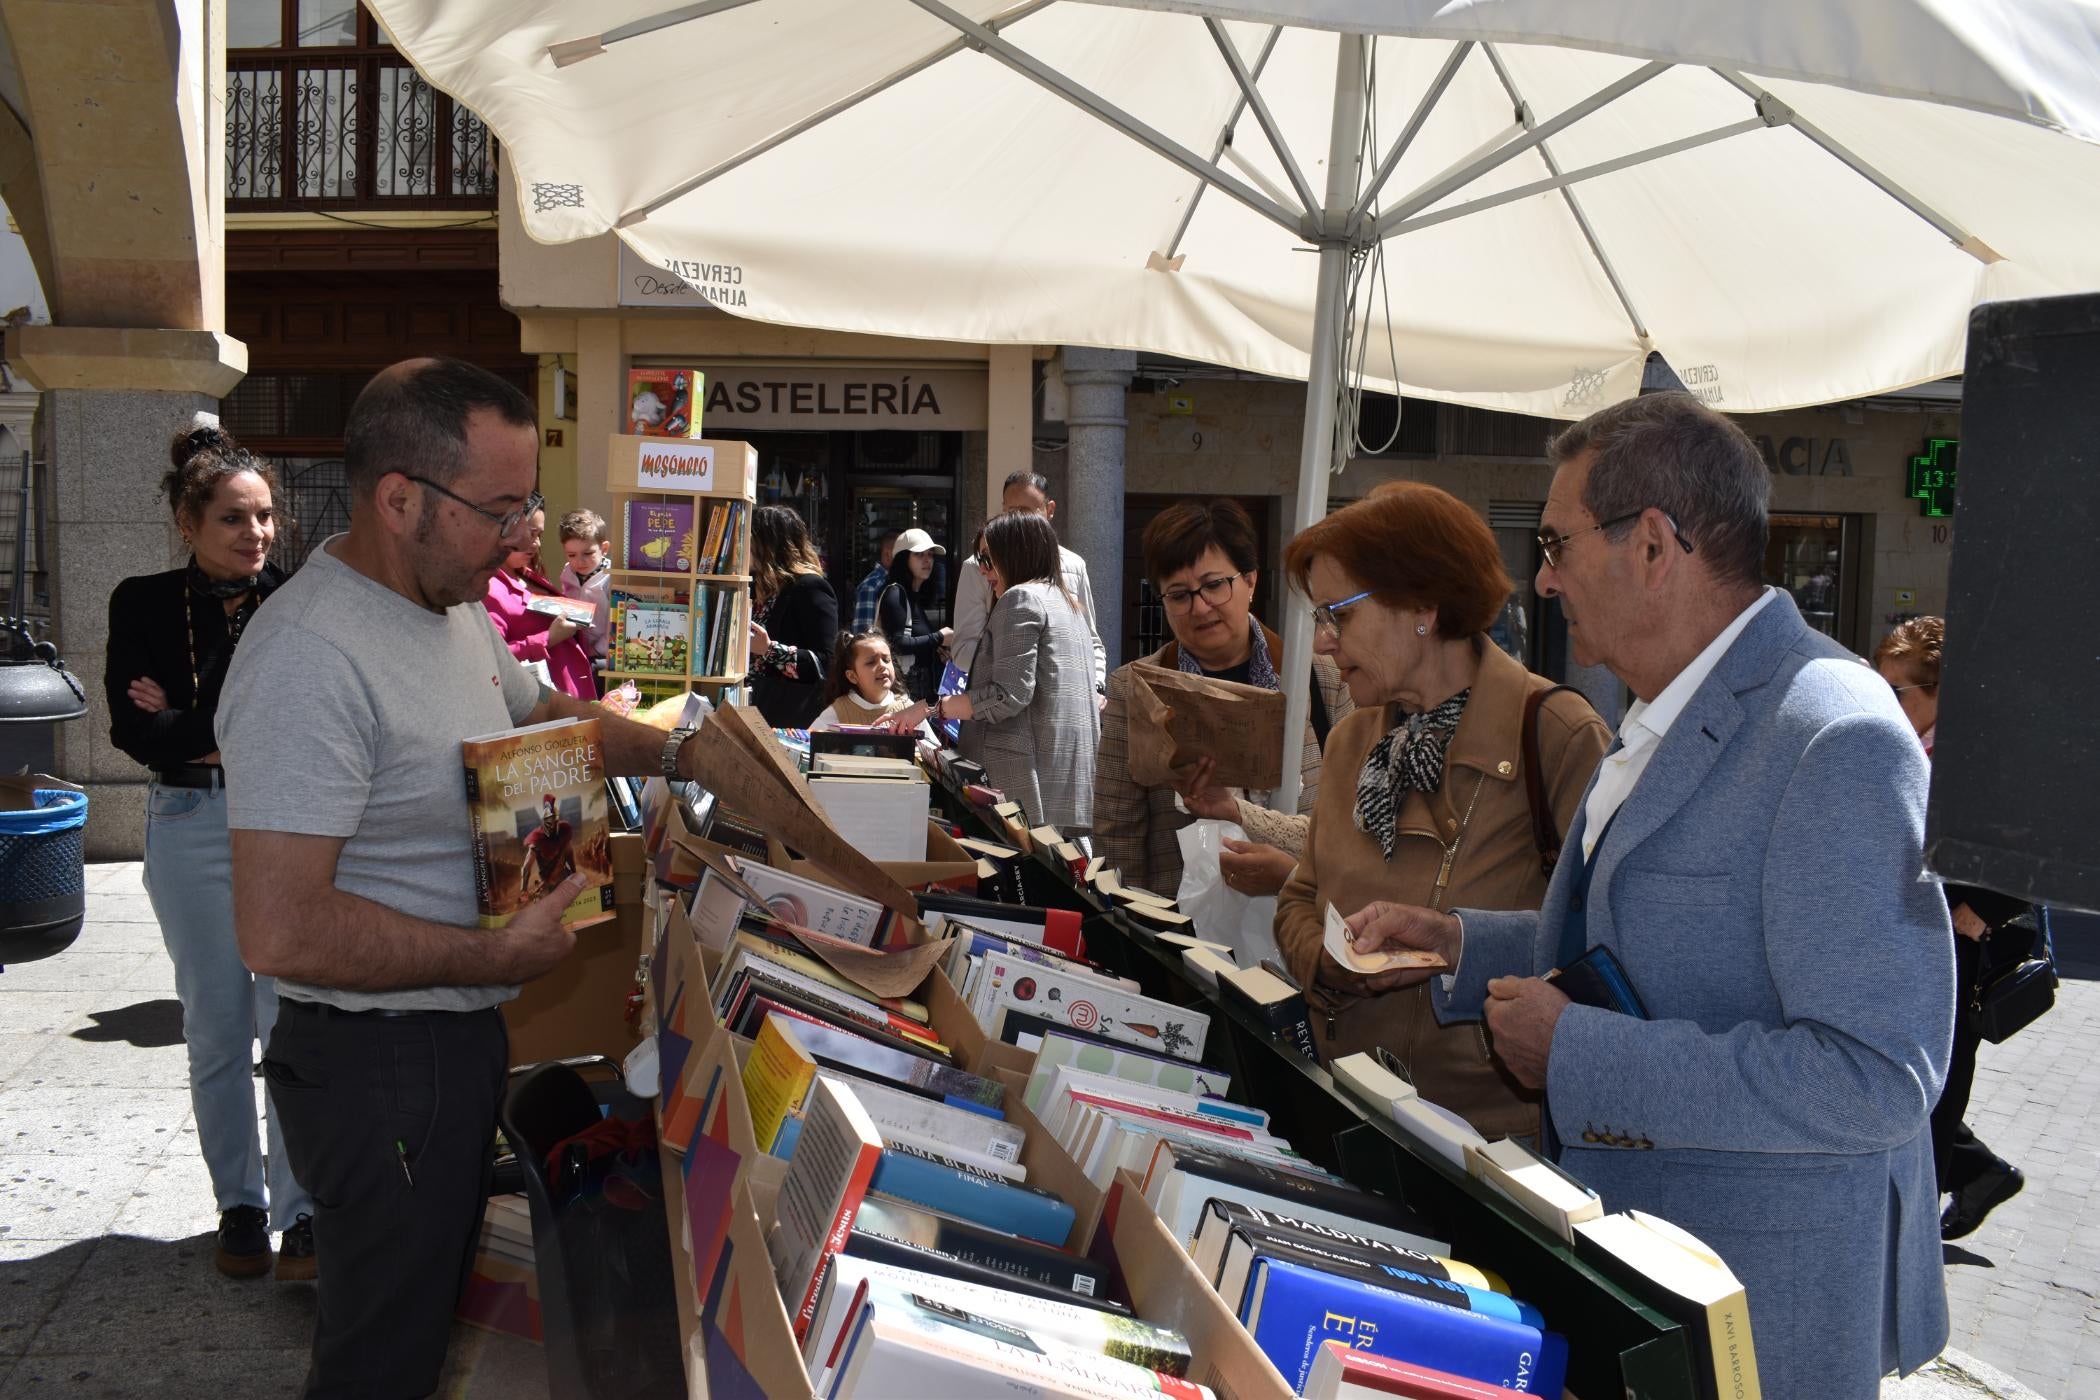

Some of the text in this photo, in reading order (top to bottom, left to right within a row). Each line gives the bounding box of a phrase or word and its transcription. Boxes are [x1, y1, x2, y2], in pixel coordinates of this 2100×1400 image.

[704, 376, 941, 415] ASTELERÍA
[1192, 432, 1202, 452] 9
[1753, 434, 1853, 476] ACIA
[647, 517, 676, 529] PEPE
[1931, 525, 1948, 544] 10
[495, 744, 596, 782] LA SANGRE
[500, 735, 588, 761] ALFONSO GOIZUETA
[503, 783, 526, 797] DEL
[529, 764, 592, 796] PADRE
[1099, 1014, 1113, 1034] SA
[943, 1157, 1009, 1186] BLANCA
[957, 1172, 990, 1189] FINAL
[1265, 1235, 1292, 1247] JUAN
[1273, 1213, 1391, 1252] MALDITA
[913, 1243, 959, 1262] Cuando
[1378, 1263, 1467, 1294] TODO VUE
[1302, 1324, 1317, 1359] Senderos
[1356, 1320, 1379, 1350] ÉR
[1725, 1312, 1745, 1400] XAVI BARROSO
[1514, 1352, 1532, 1392] GAR
